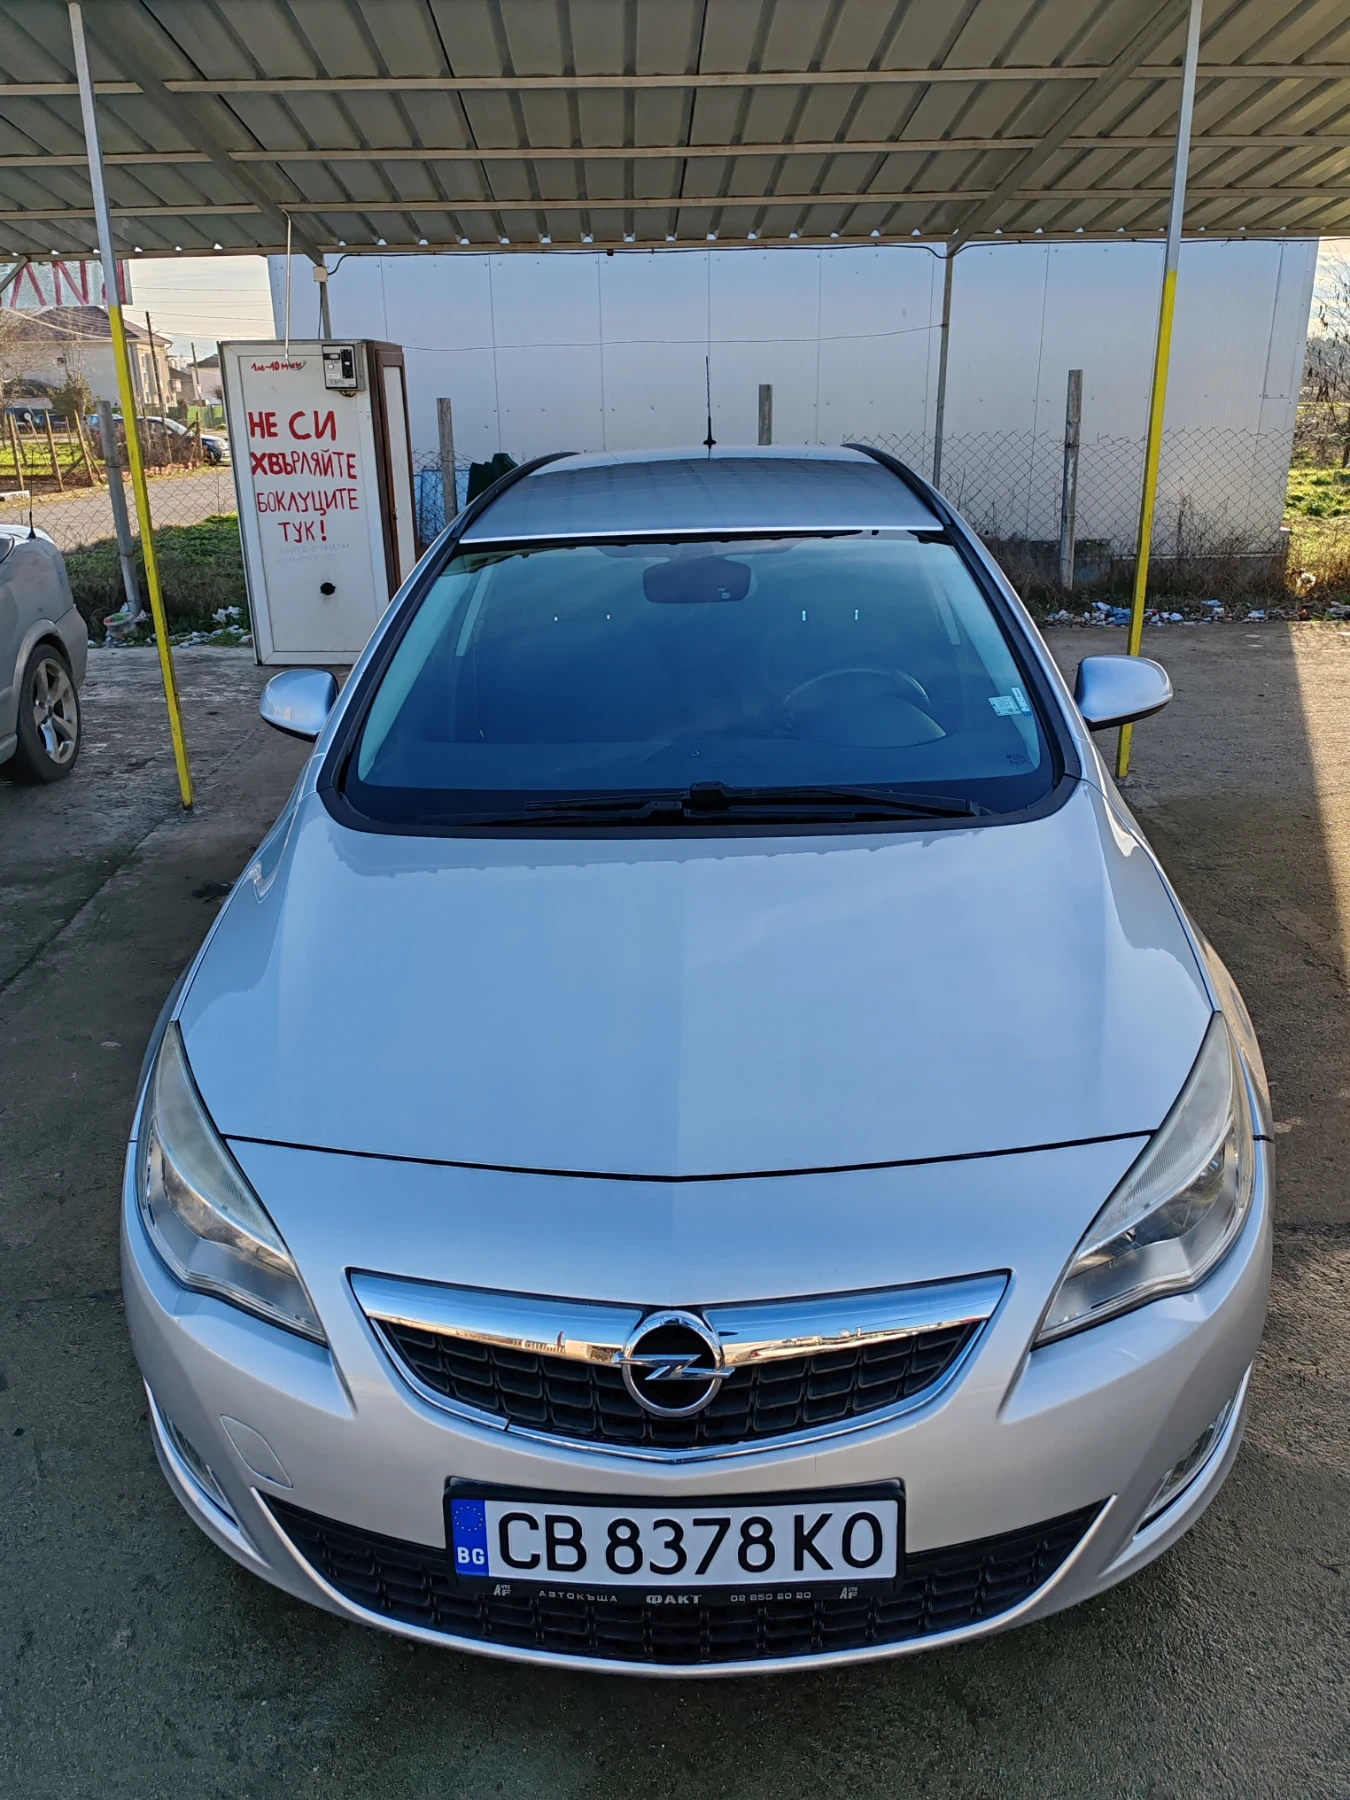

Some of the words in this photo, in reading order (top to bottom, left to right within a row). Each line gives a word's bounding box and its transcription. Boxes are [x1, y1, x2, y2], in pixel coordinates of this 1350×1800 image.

[247, 411, 279, 439] НЕ
[288, 410, 337, 441] СИ
[250, 448, 358, 480] ХВЪРЛЯЙТЕ
[256, 487, 360, 516] БОКЛУЦИТЕ
[457, 1546, 486, 1565] BG
[498, 1511, 588, 1573] CB
[605, 1515, 776, 1575] 8378
[538, 1590, 618, 1603] АВТОКЪША
[645, 1594, 702, 1605] ФАКТ
[730, 1594, 746, 1602] 02
[776, 1592, 792, 1600] 20
[795, 1591, 812, 1599] 20
